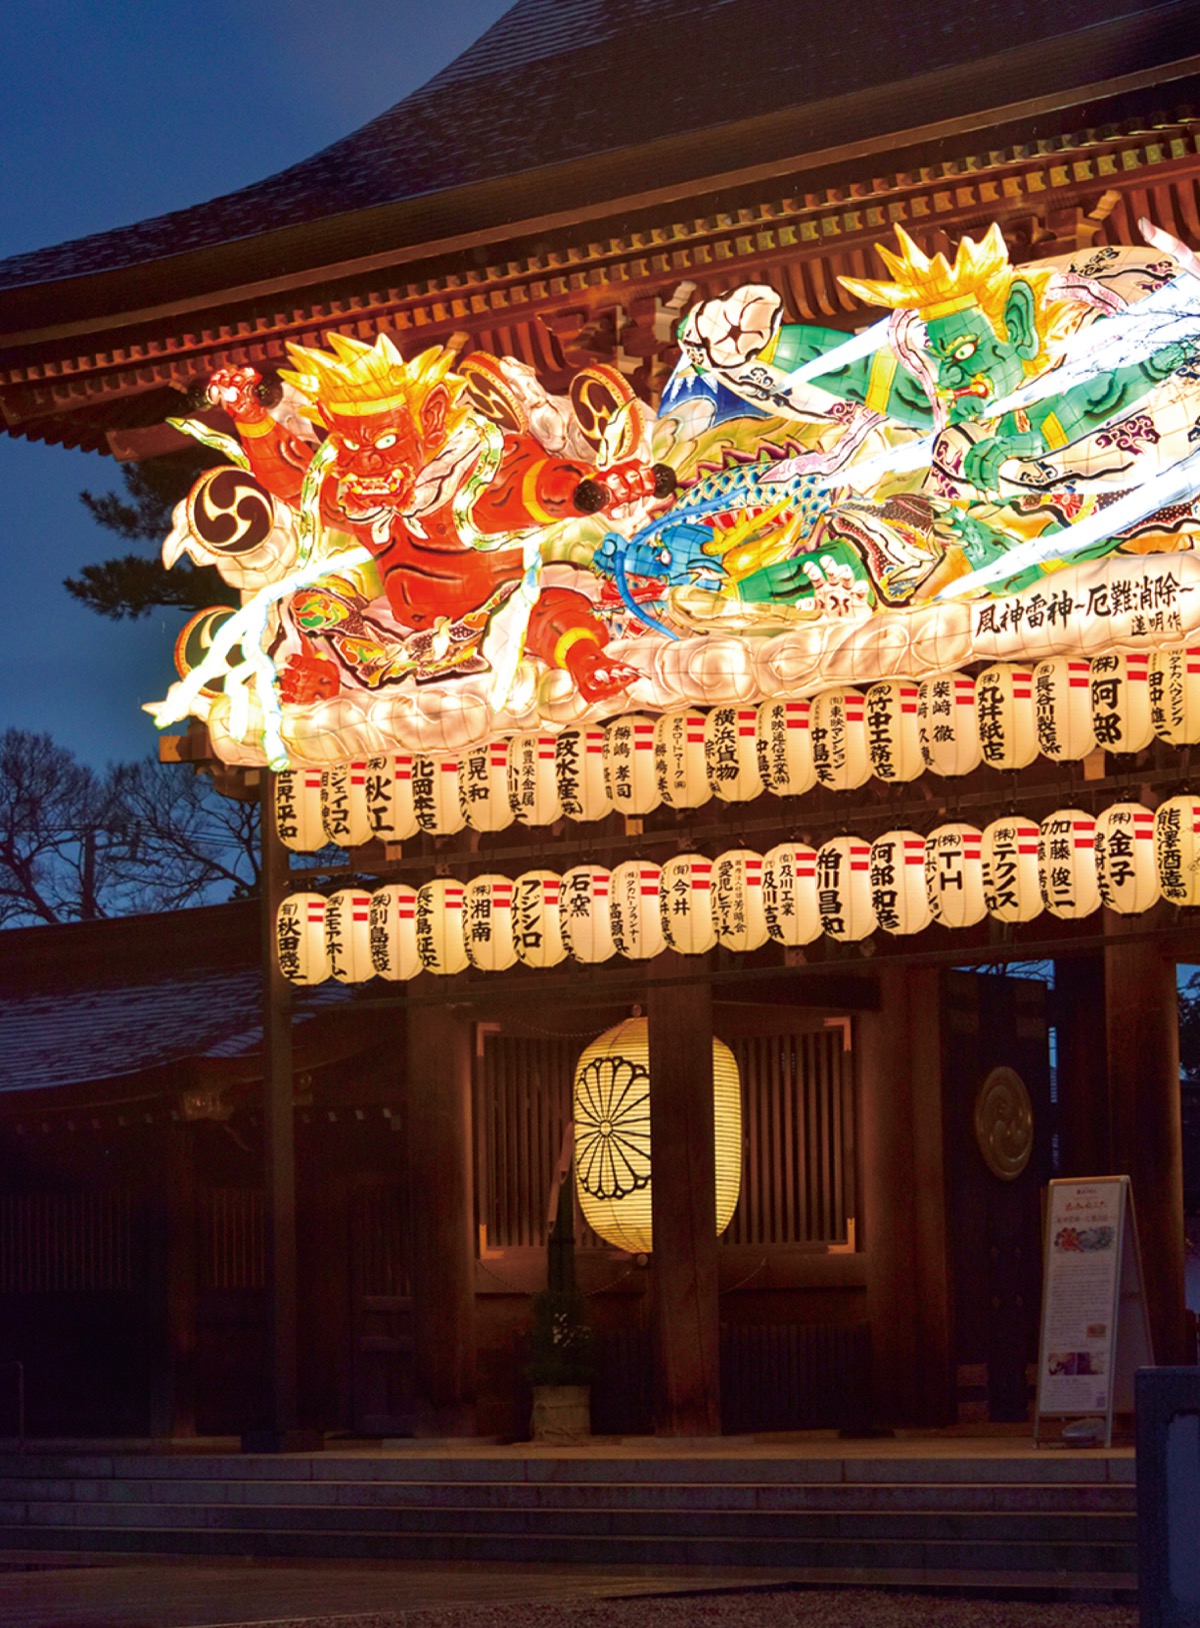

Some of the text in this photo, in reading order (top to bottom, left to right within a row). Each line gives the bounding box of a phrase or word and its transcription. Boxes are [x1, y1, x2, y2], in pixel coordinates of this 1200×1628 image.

[521, 879, 543, 948] フジシロ
[569, 873, 591, 918] 石窯
[871, 841, 900, 929] 阿部和彦
